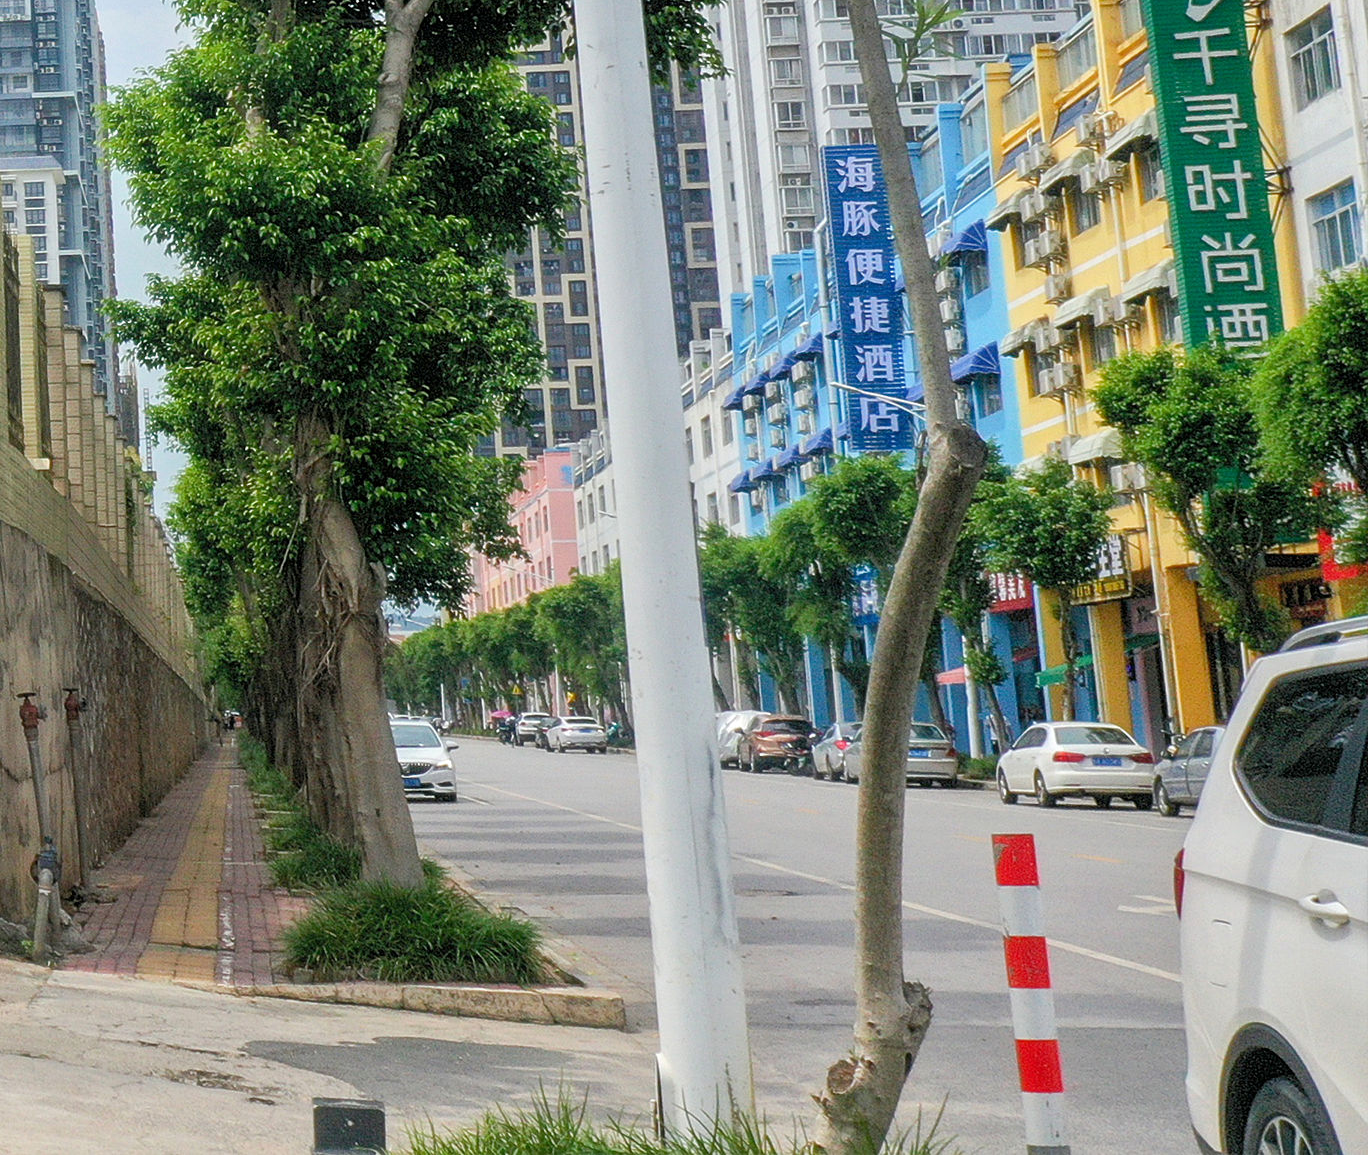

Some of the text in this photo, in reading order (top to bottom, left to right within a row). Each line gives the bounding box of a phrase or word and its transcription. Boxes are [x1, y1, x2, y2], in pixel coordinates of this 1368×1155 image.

[835, 156, 900, 434] 海豚便捷酒店
